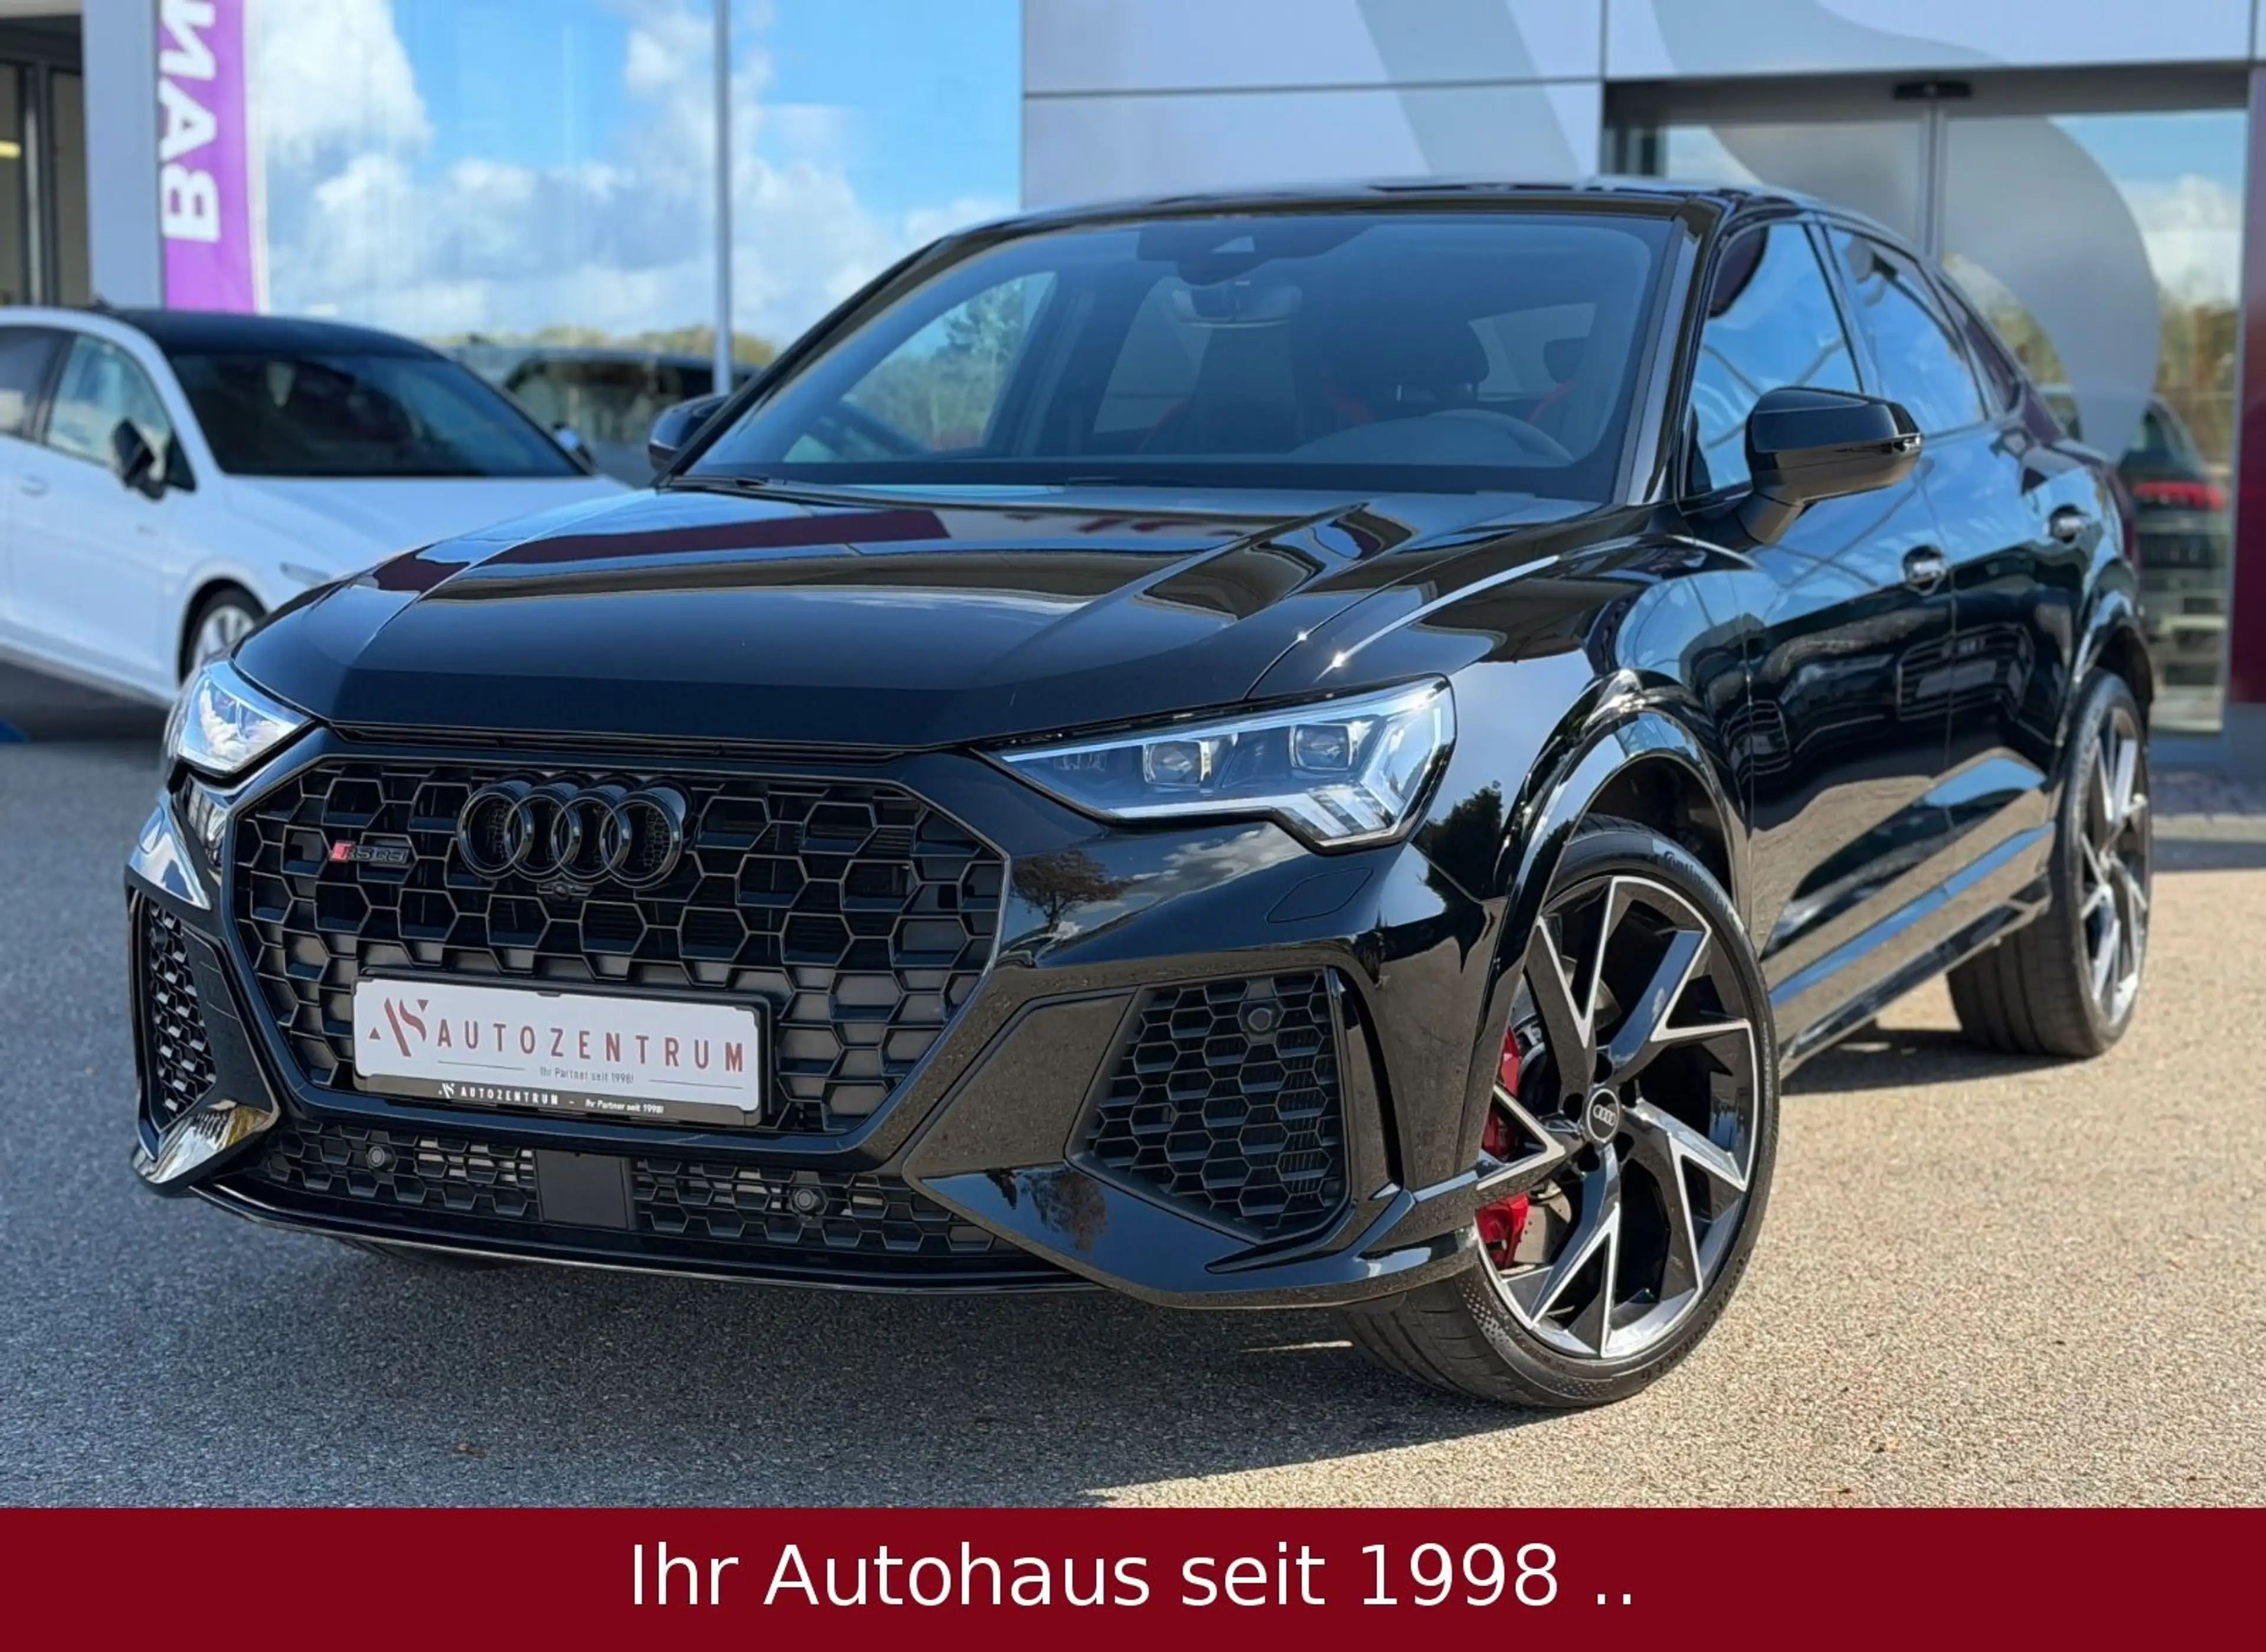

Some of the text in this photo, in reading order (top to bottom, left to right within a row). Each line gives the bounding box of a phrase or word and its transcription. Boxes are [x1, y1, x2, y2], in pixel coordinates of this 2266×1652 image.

[437, 1018, 744, 1073] AUTOZENTRUM
[540, 1066, 552, 1077] Ihr
[555, 1067, 588, 1080] Partner
[591, 1072, 608, 1083] seit
[461, 1086, 559, 1106] AUTOZENTRUM
[585, 1098, 595, 1109] Ihr
[597, 1099, 625, 1111] Partner
[627, 1102, 641, 1112] seit
